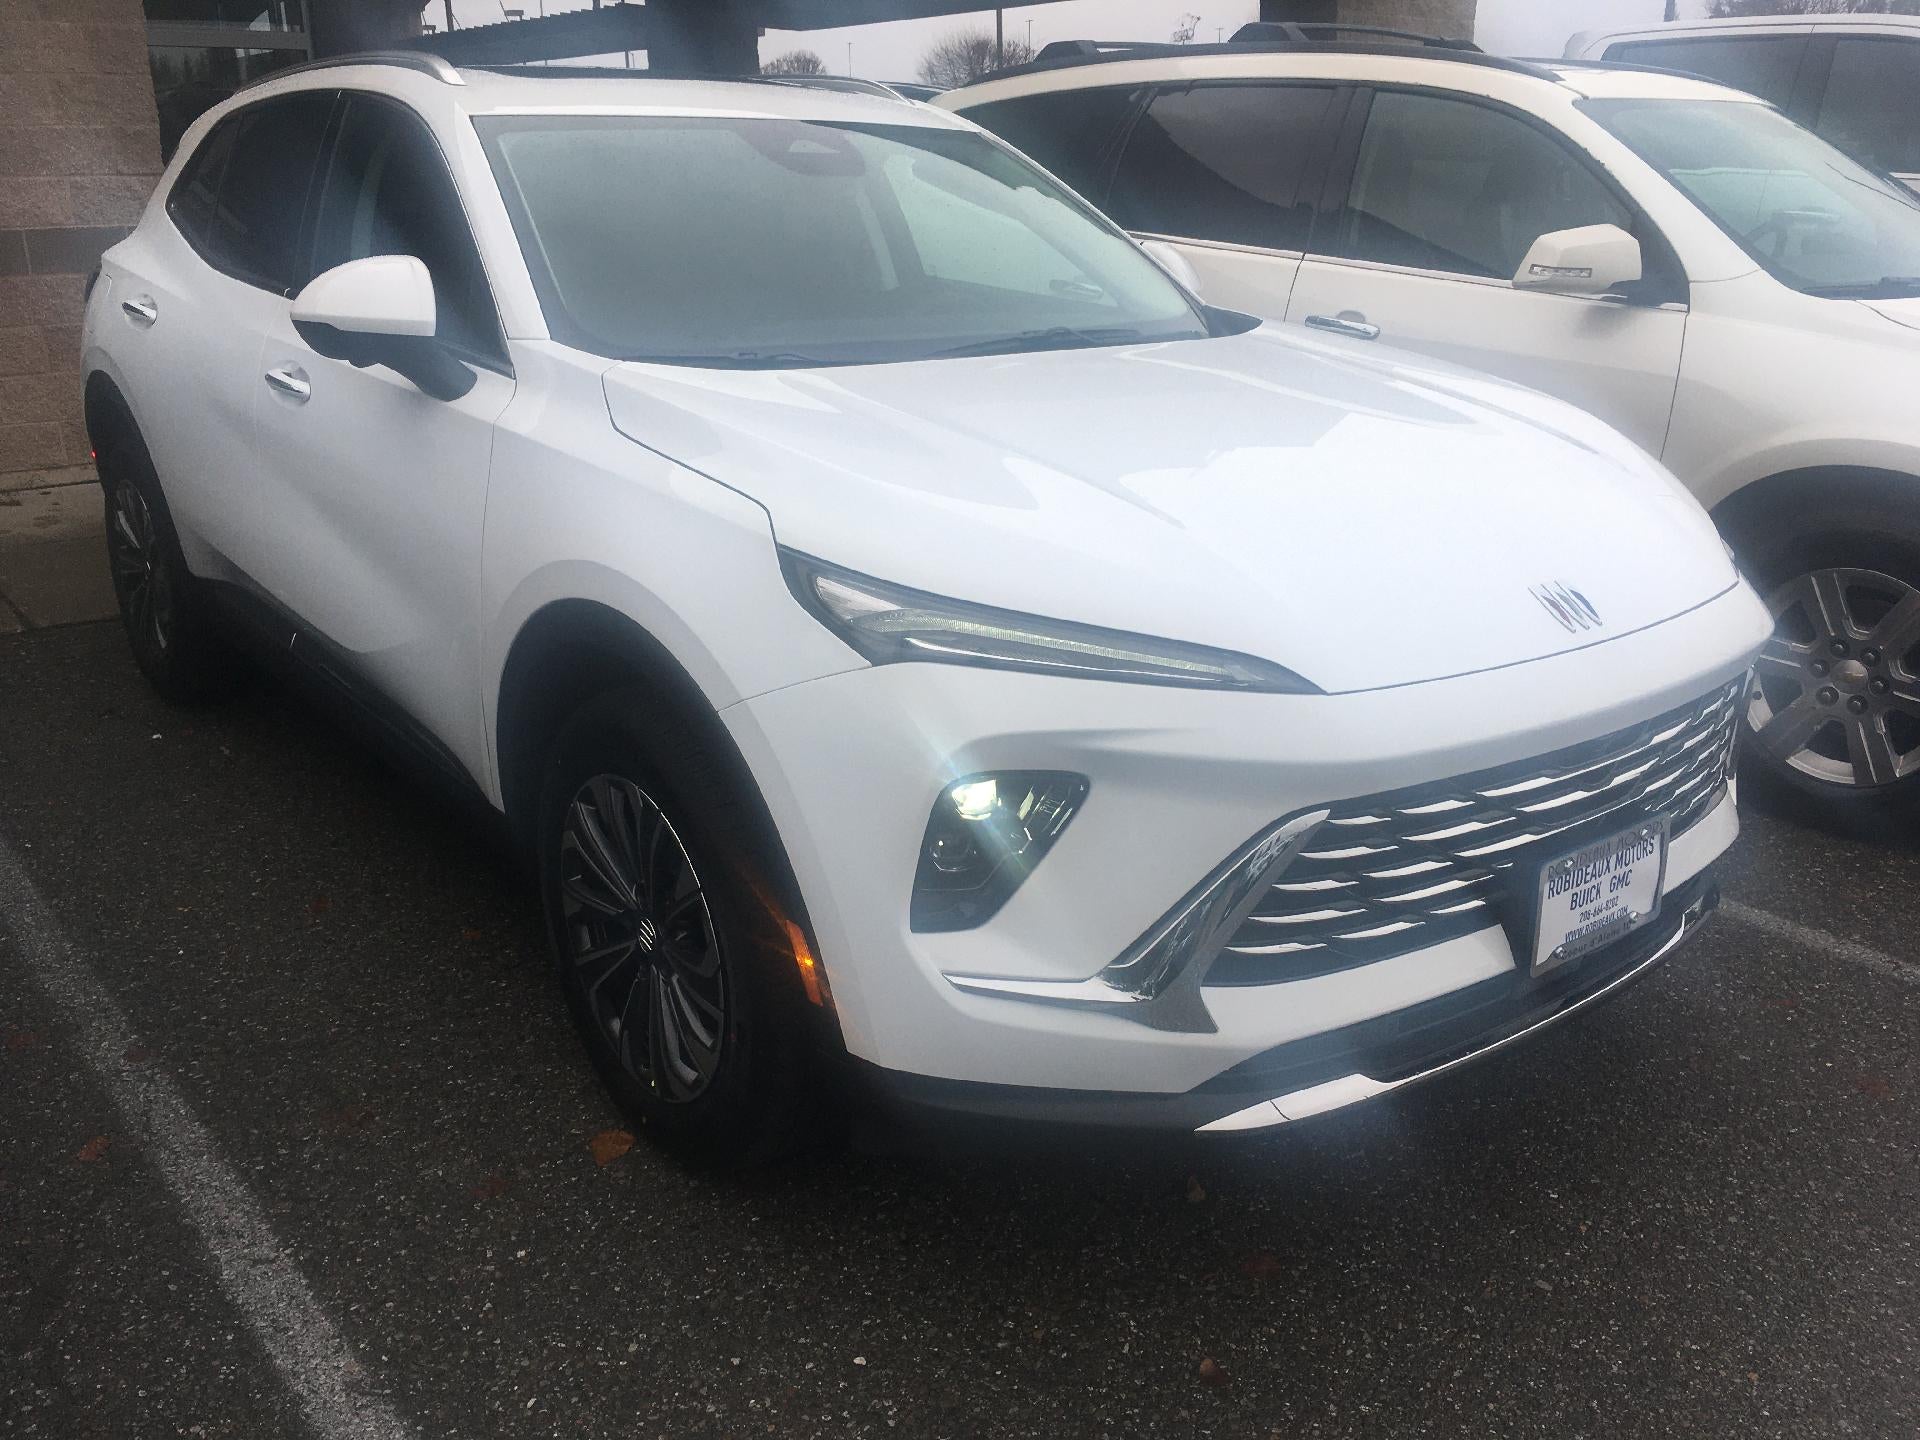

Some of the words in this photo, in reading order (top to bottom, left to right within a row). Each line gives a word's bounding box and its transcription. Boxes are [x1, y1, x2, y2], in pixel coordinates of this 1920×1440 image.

[1548, 856, 1611, 899] ROBIDEAUX
[1615, 837, 1654, 871] MOTORS
[1570, 882, 1602, 911] BUICK
[1609, 869, 1633, 893] GMC
